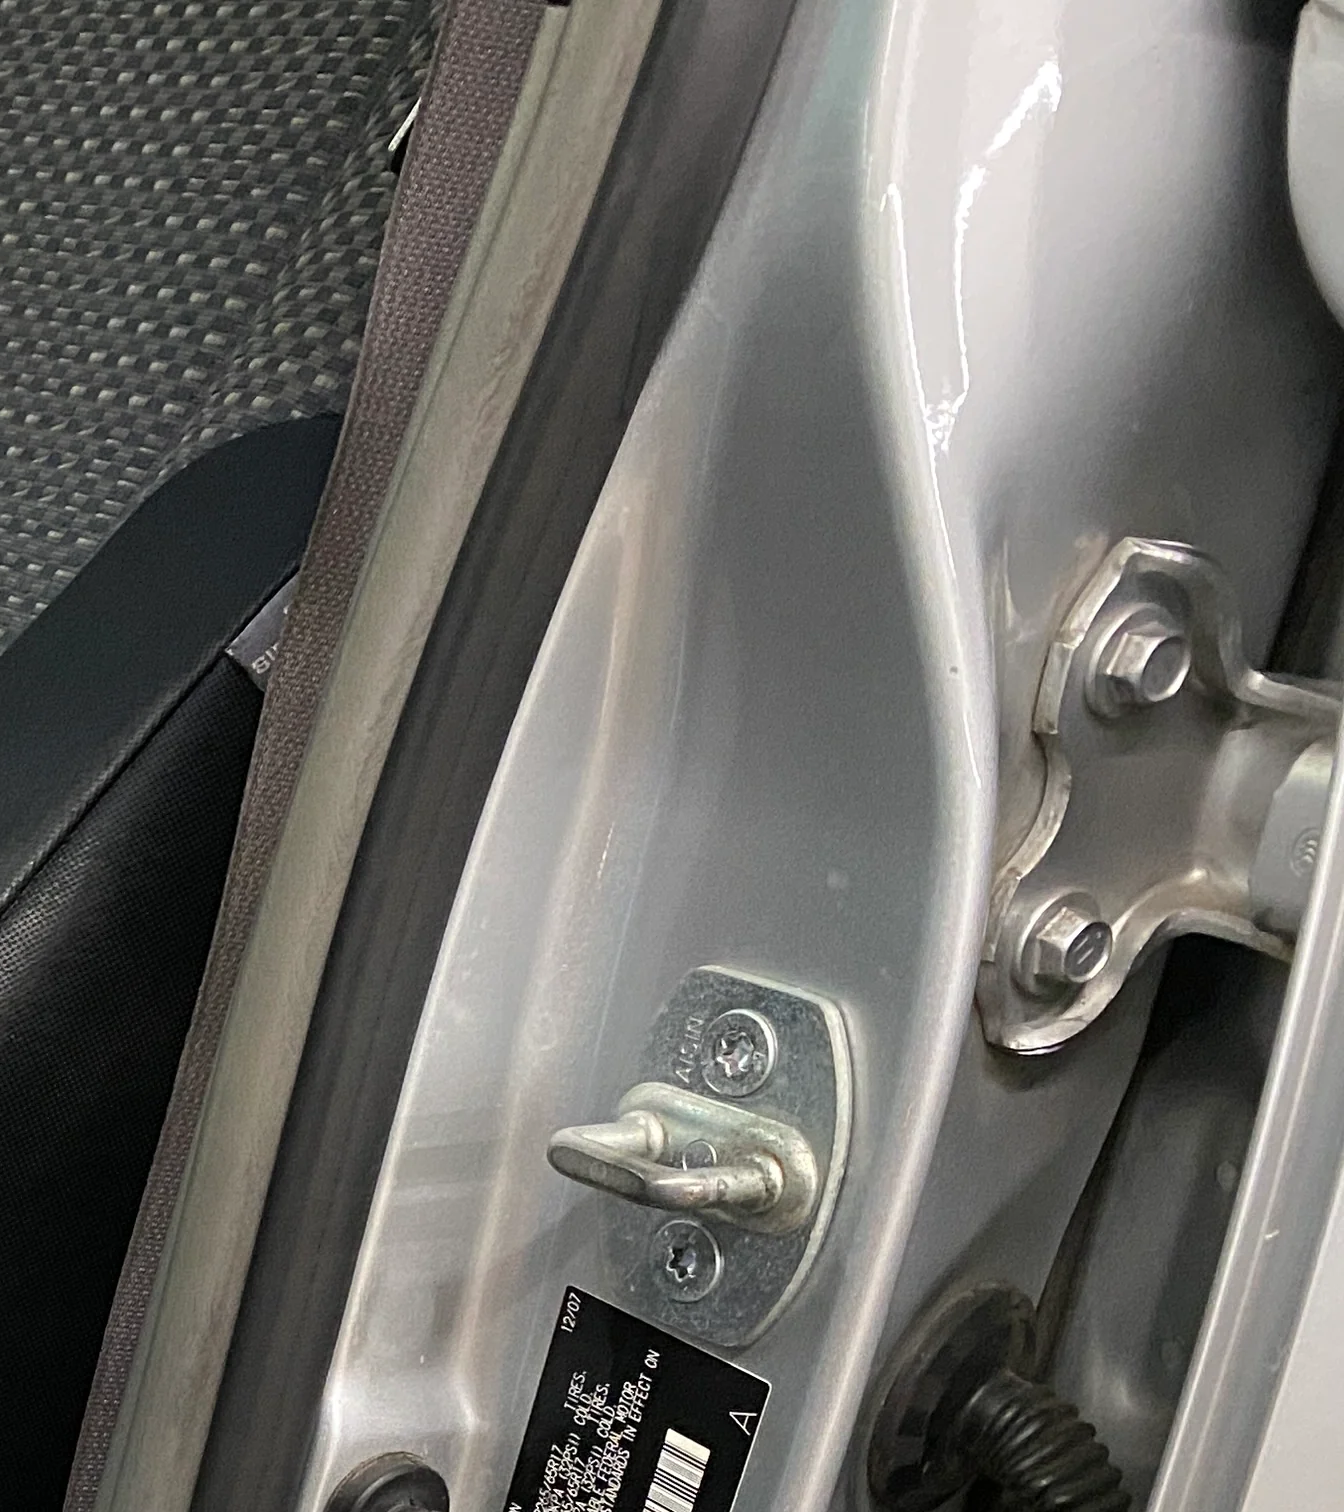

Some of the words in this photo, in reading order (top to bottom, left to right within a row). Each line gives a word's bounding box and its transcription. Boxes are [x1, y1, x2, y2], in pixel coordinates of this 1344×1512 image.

[560, 1292, 581, 1333] 12/07
[644, 1349, 660, 1369] ON
[563, 1371, 587, 1414] TIRES.
[586, 1383, 611, 1426] TIRES.
[627, 1372, 652, 1423] EFFECT
[596, 1430, 625, 1485] FEDERAL
[613, 1381, 639, 1424] MOTOR
[621, 1424, 638, 1442] IN
[729, 1411, 758, 1436] A
